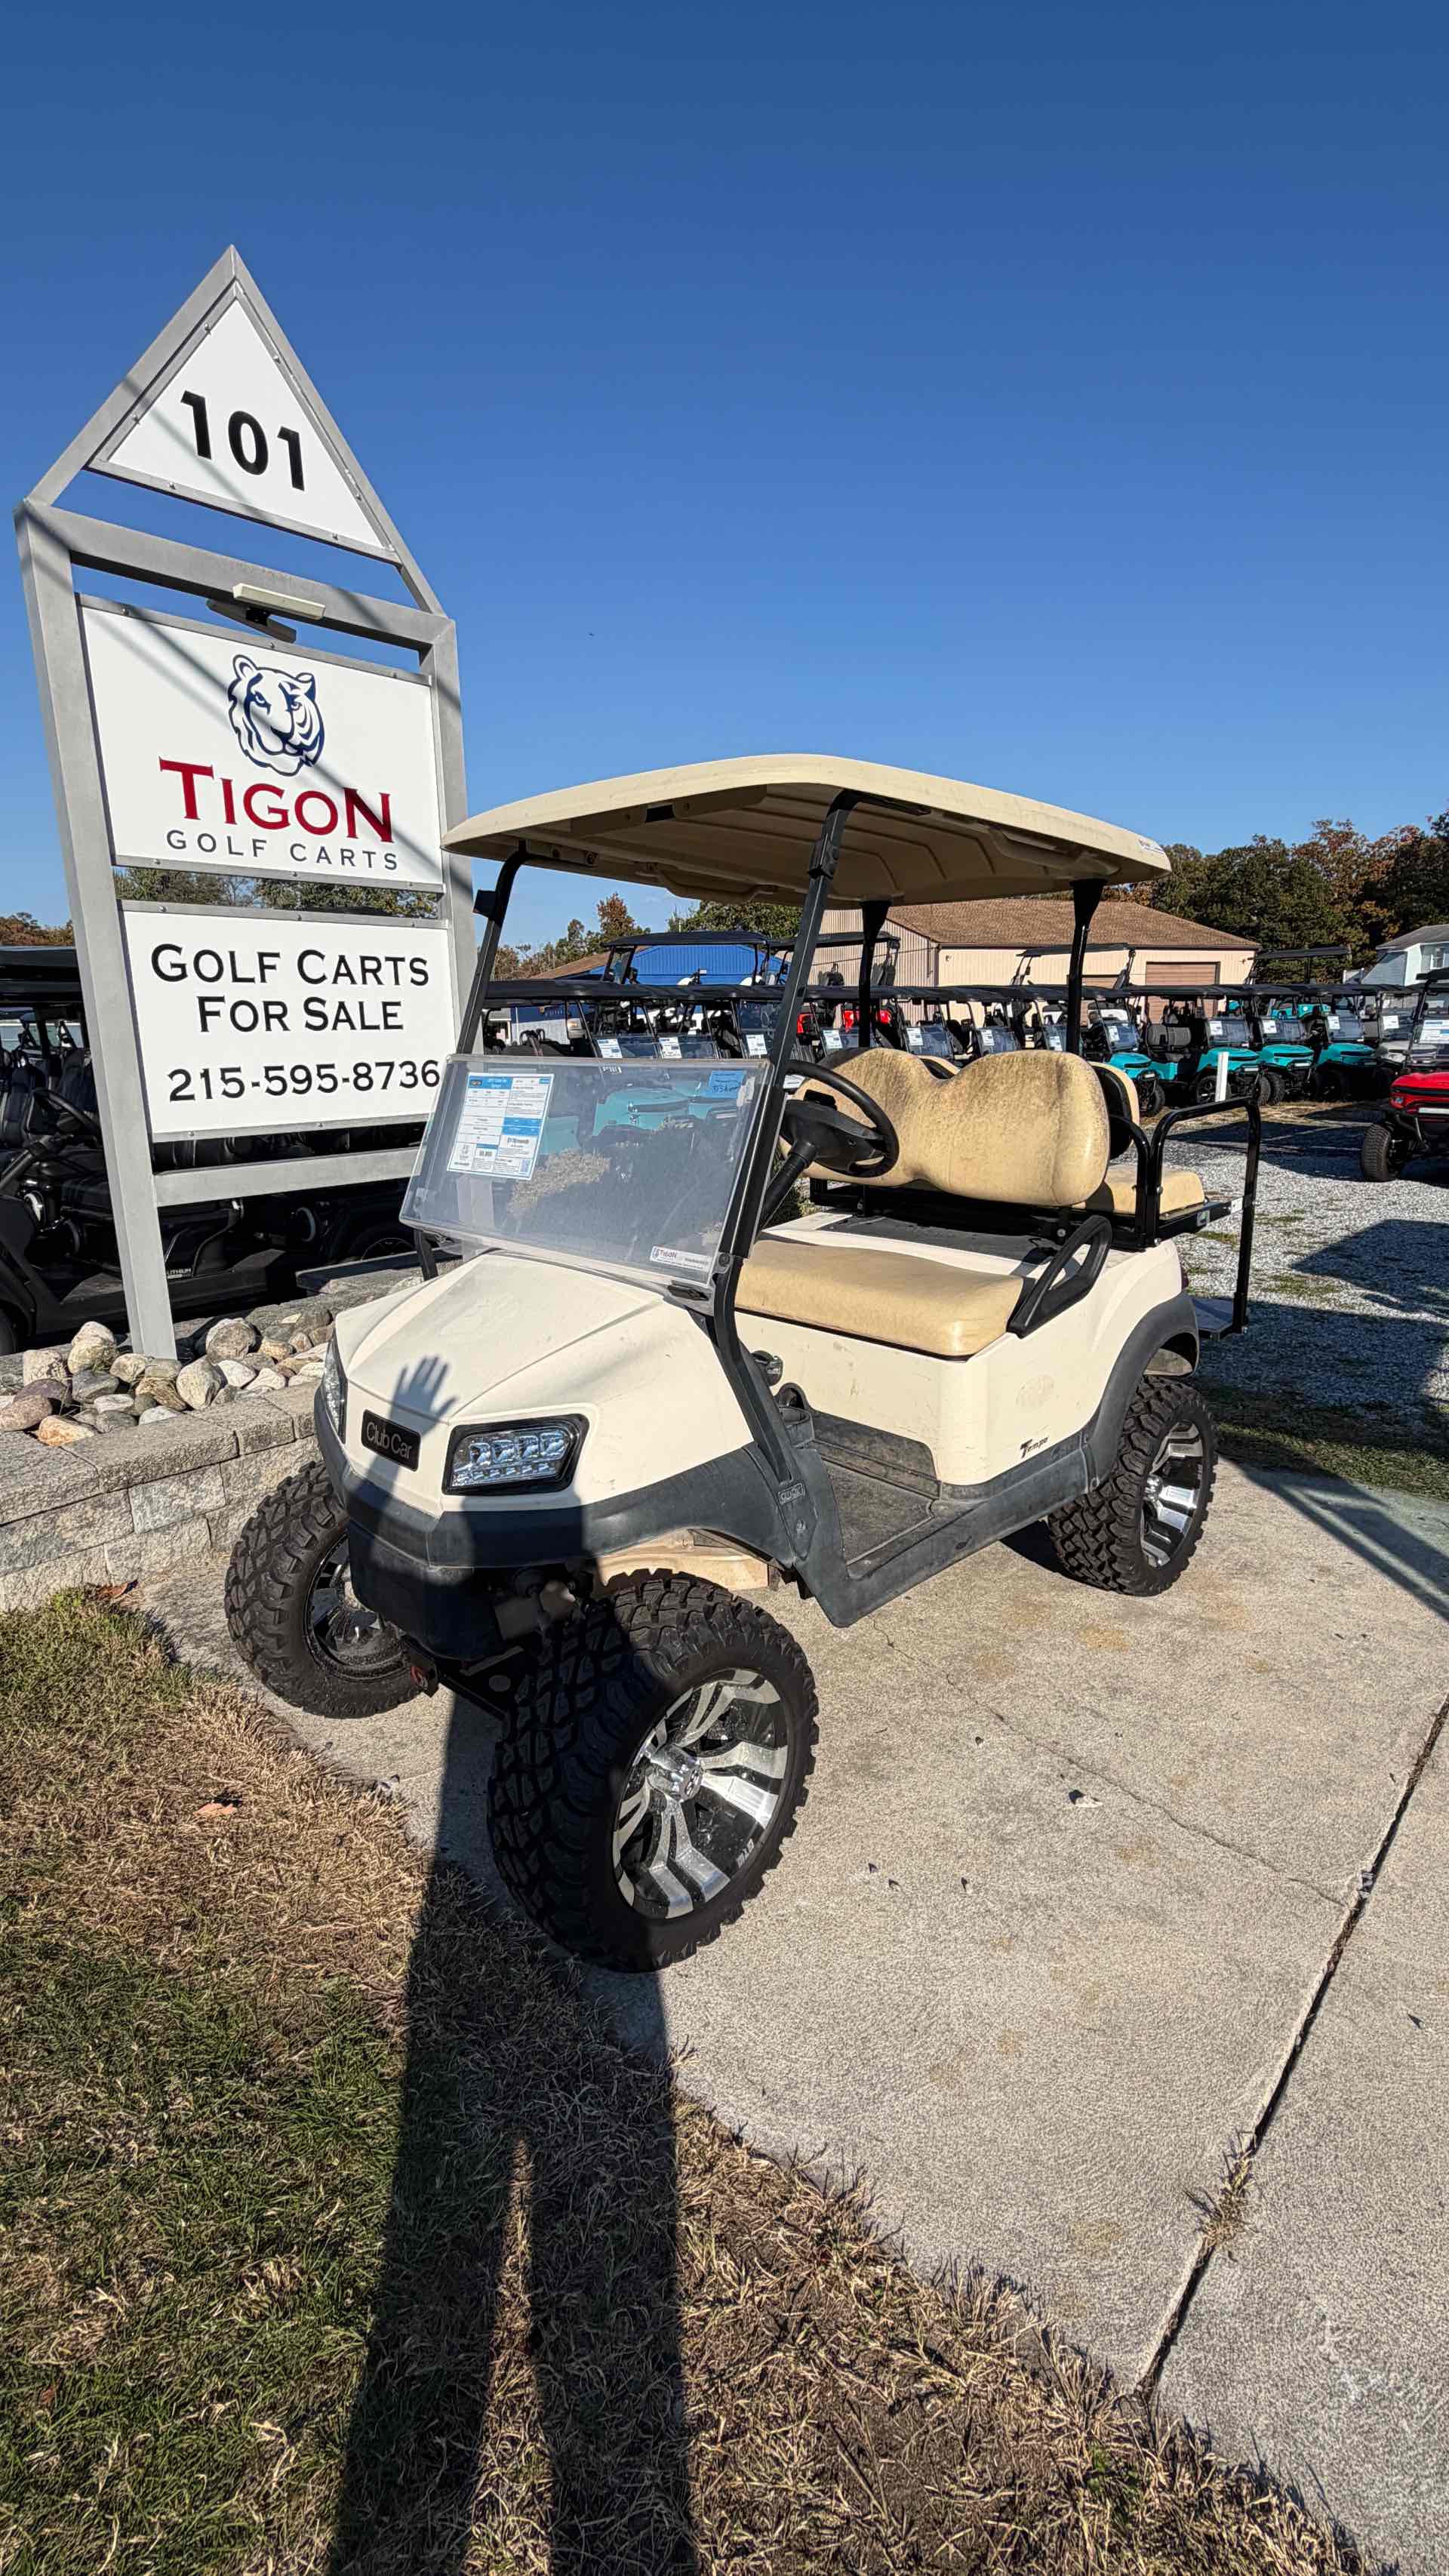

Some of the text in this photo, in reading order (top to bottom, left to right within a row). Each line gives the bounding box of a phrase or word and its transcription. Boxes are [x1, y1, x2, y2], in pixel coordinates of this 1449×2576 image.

[181, 391, 305, 491] 101
[159, 757, 394, 843] TIGON
[167, 829, 398, 870] GOLF CARTS
[152, 943, 429, 986] GOLF CARTS
[198, 996, 404, 1033] FOR SALE
[168, 1060, 441, 1102] 215-595-8736
[366, 1421, 413, 1459] Club Car
